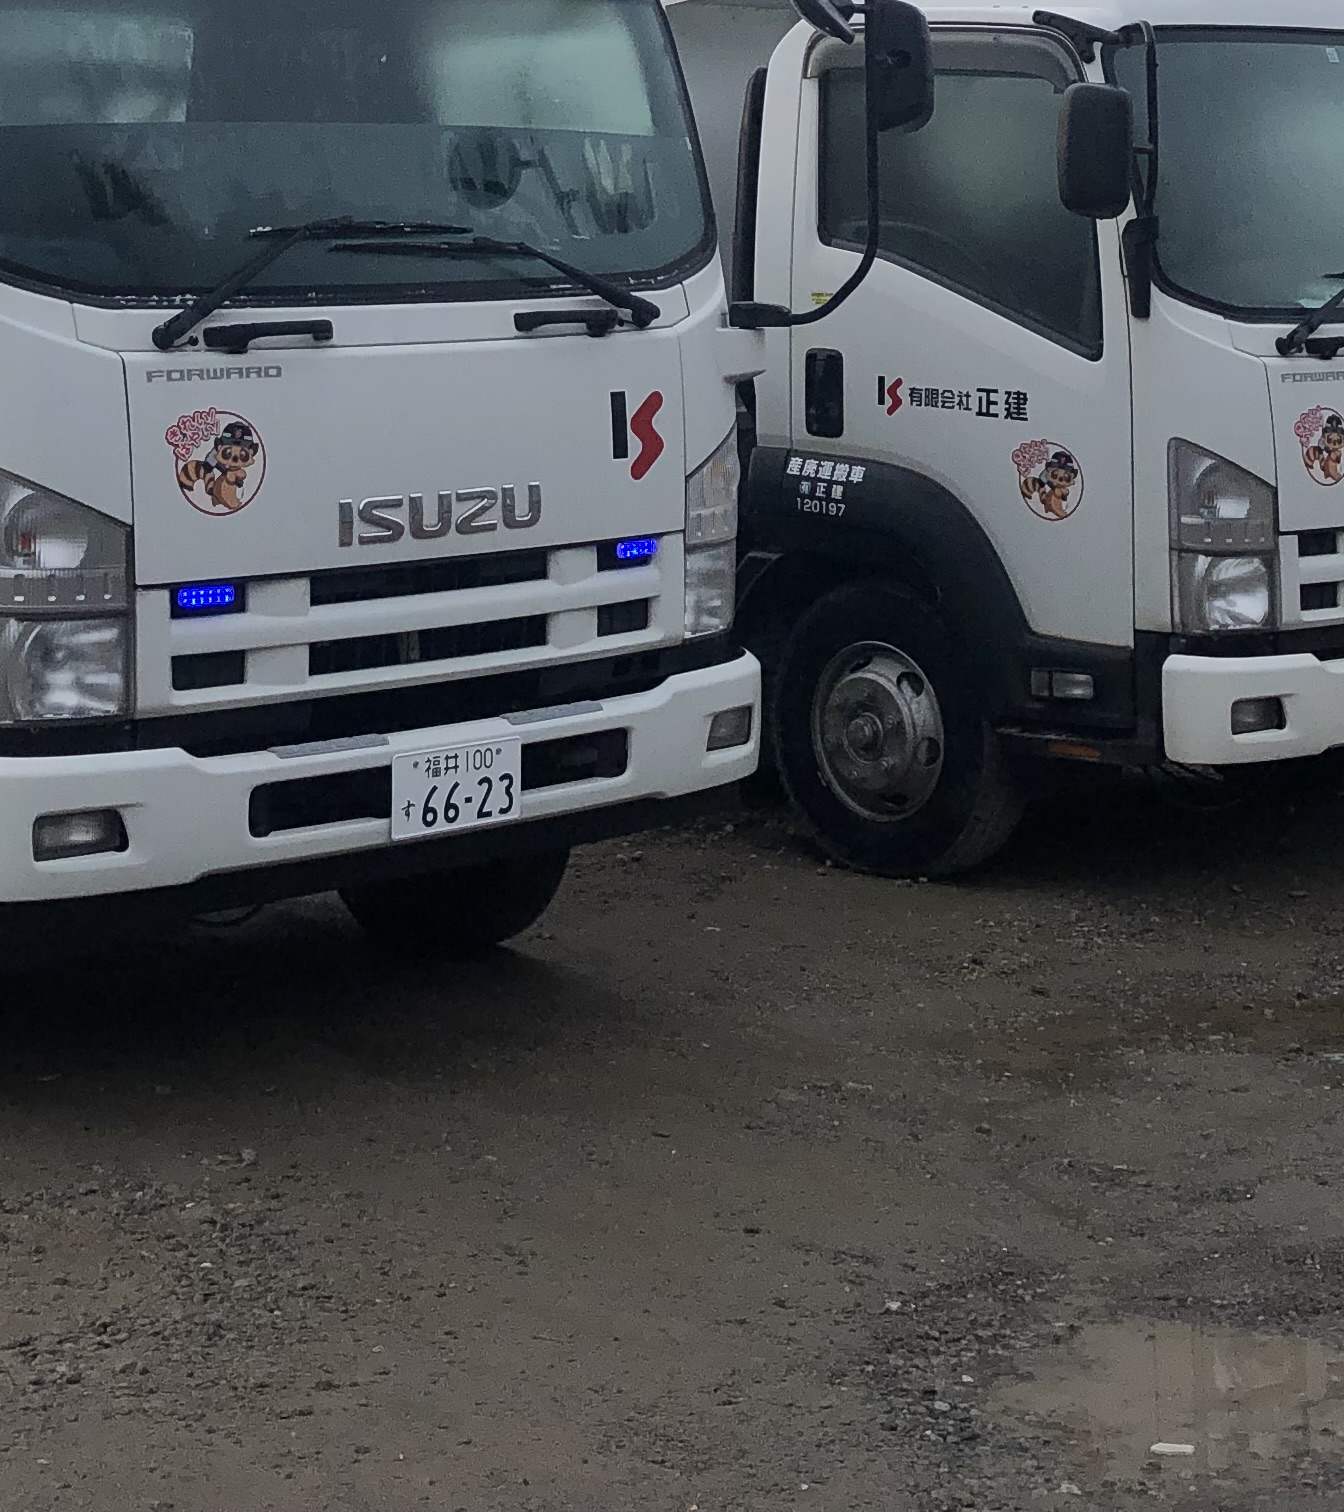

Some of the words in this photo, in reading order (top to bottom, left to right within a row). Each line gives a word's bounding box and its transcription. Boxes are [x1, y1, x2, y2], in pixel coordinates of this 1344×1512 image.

[145, 365, 283, 383] FORWARD
[786, 456, 867, 484] 産廃運搬車
[338, 480, 542, 548] ISUZU
[796, 497, 846, 517] 120197
[424, 752, 460, 779] 福井
[464, 746, 494, 773] 100
[400, 798, 416, 822] す
[420, 771, 514, 828] 66-23
